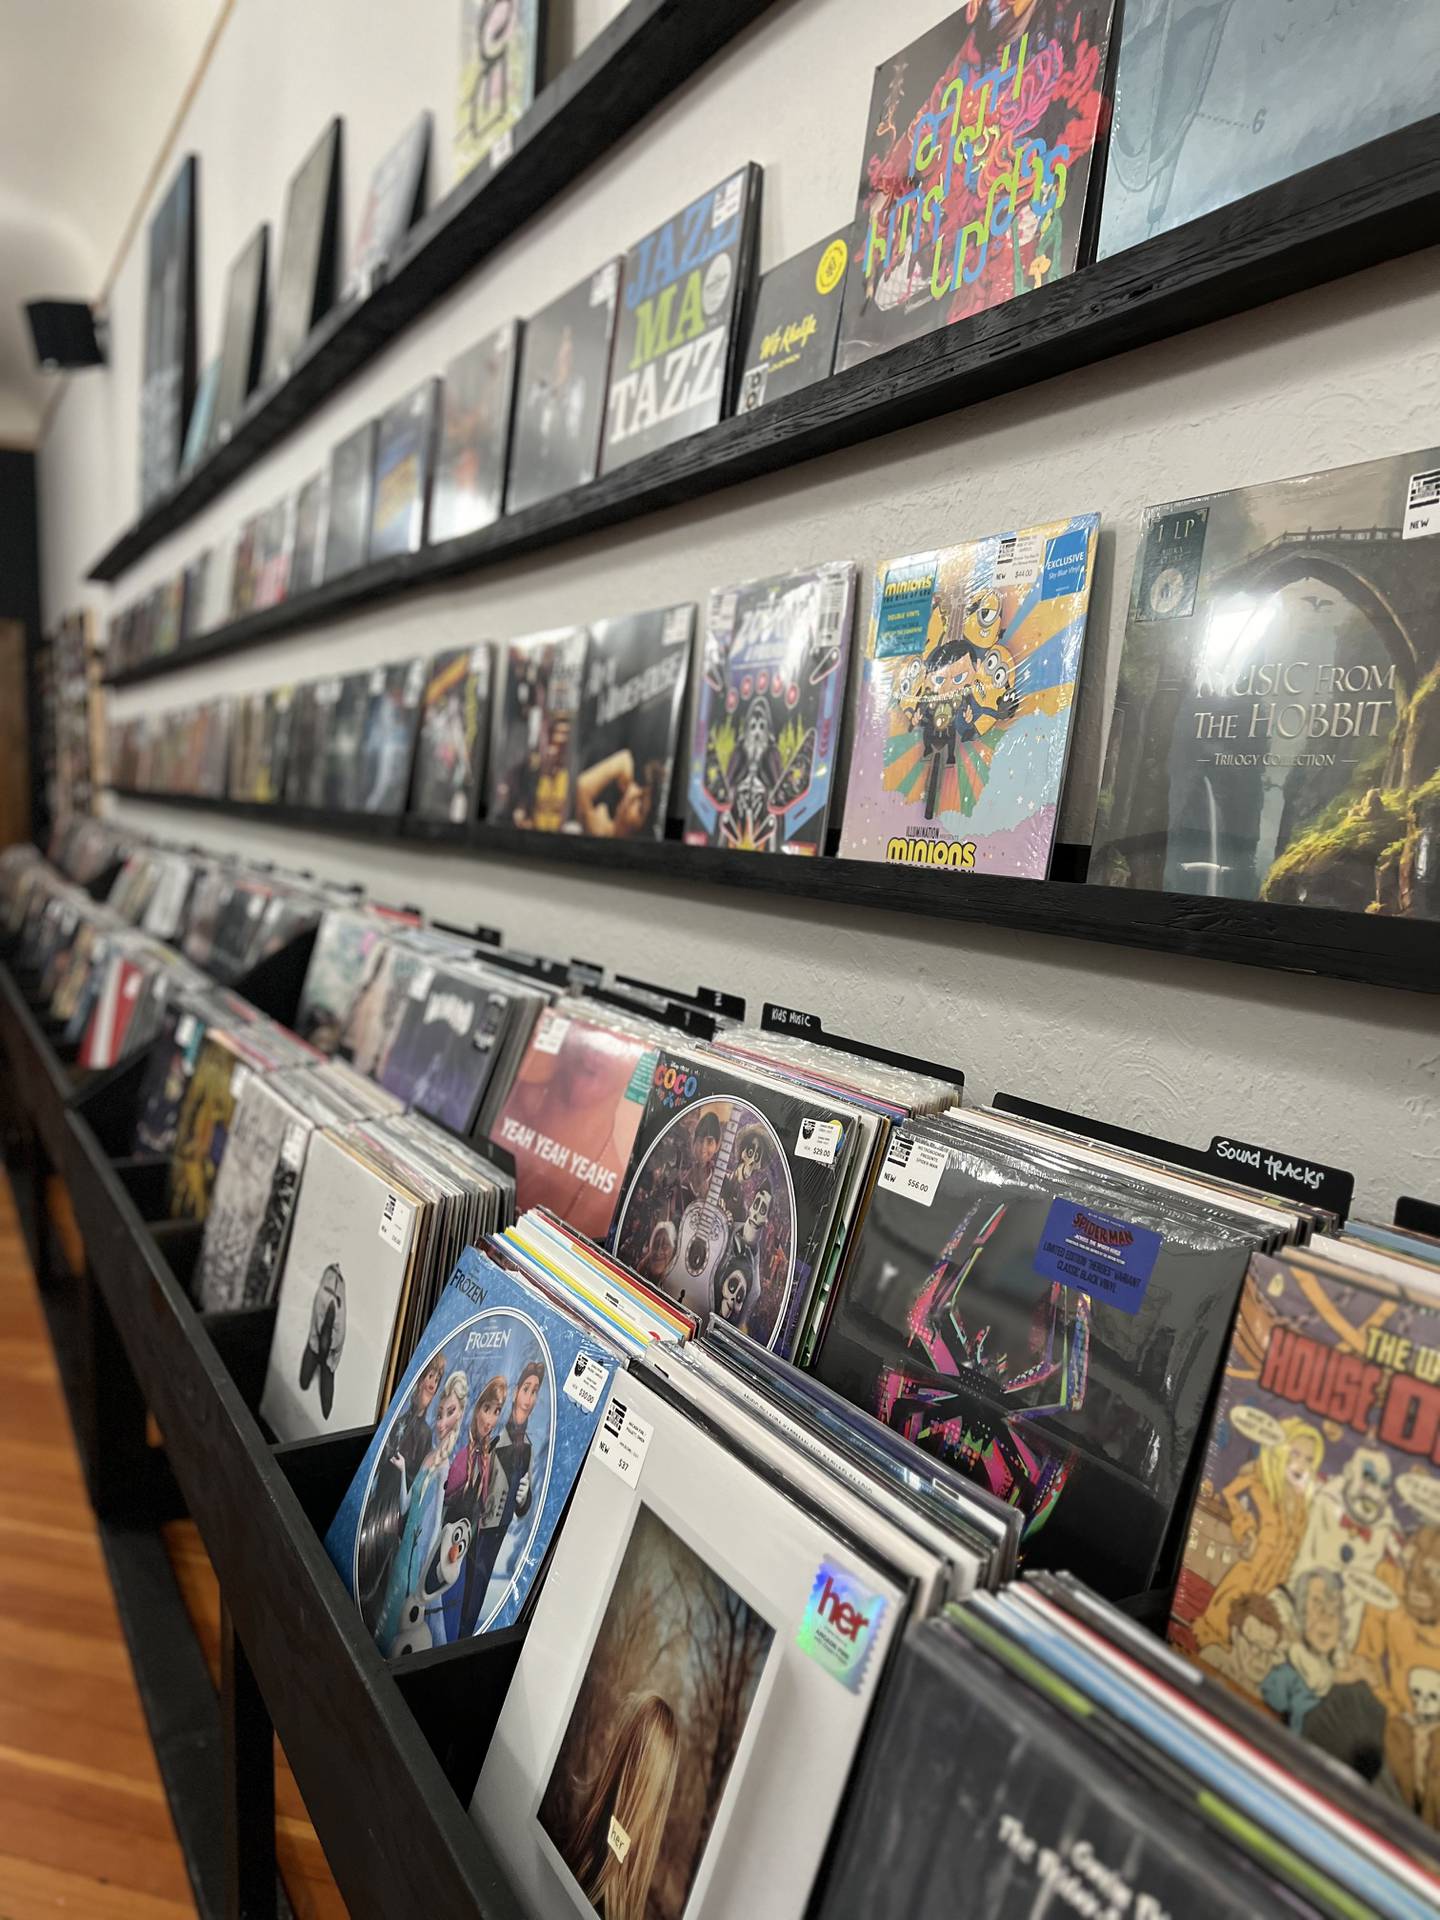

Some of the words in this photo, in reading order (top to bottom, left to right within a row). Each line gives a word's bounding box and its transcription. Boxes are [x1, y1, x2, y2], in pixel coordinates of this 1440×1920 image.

[1252, 108, 1267, 134] 6
[628, 268, 704, 370] MA
[608, 325, 727, 444] TAZZ
[1174, 519, 1195, 539] LP
[1409, 518, 1430, 530] NEW
[1046, 551, 1085, 570] EXCLUSIVE
[1194, 661, 1310, 698] MUSIC
[1315, 663, 1397, 695] FROM
[1194, 712, 1239, 739] THE
[1248, 701, 1392, 738] HOBBIT
[1214, 752, 1258, 767] TRILOGY
[905, 826, 940, 839] ILLUMINATION
[655, 1064, 698, 1098] COCO
[501, 1117, 536, 1150] YEAH
[534, 1133, 571, 1169] YEAH
[568, 1151, 618, 1194] YEAHS
[1216, 1141, 1262, 1169] Sound
[884, 1172, 896, 1183] NEW
[908, 1178, 929, 1193] $56.00
[1043, 1241, 1065, 1258] LIMITED
[450, 1268, 489, 1306] FROZEN
[464, 1327, 512, 1352] FROZEN
[1366, 1327, 1412, 1372] THE
[1415, 1346, 1440, 1385] W
[1260, 1325, 1383, 1434] HOUSE
[1378, 1373, 1440, 1468] O
[599, 1441, 610, 1454] NEW
[618, 1459, 629, 1471] $37
[817, 1576, 870, 1643] her
